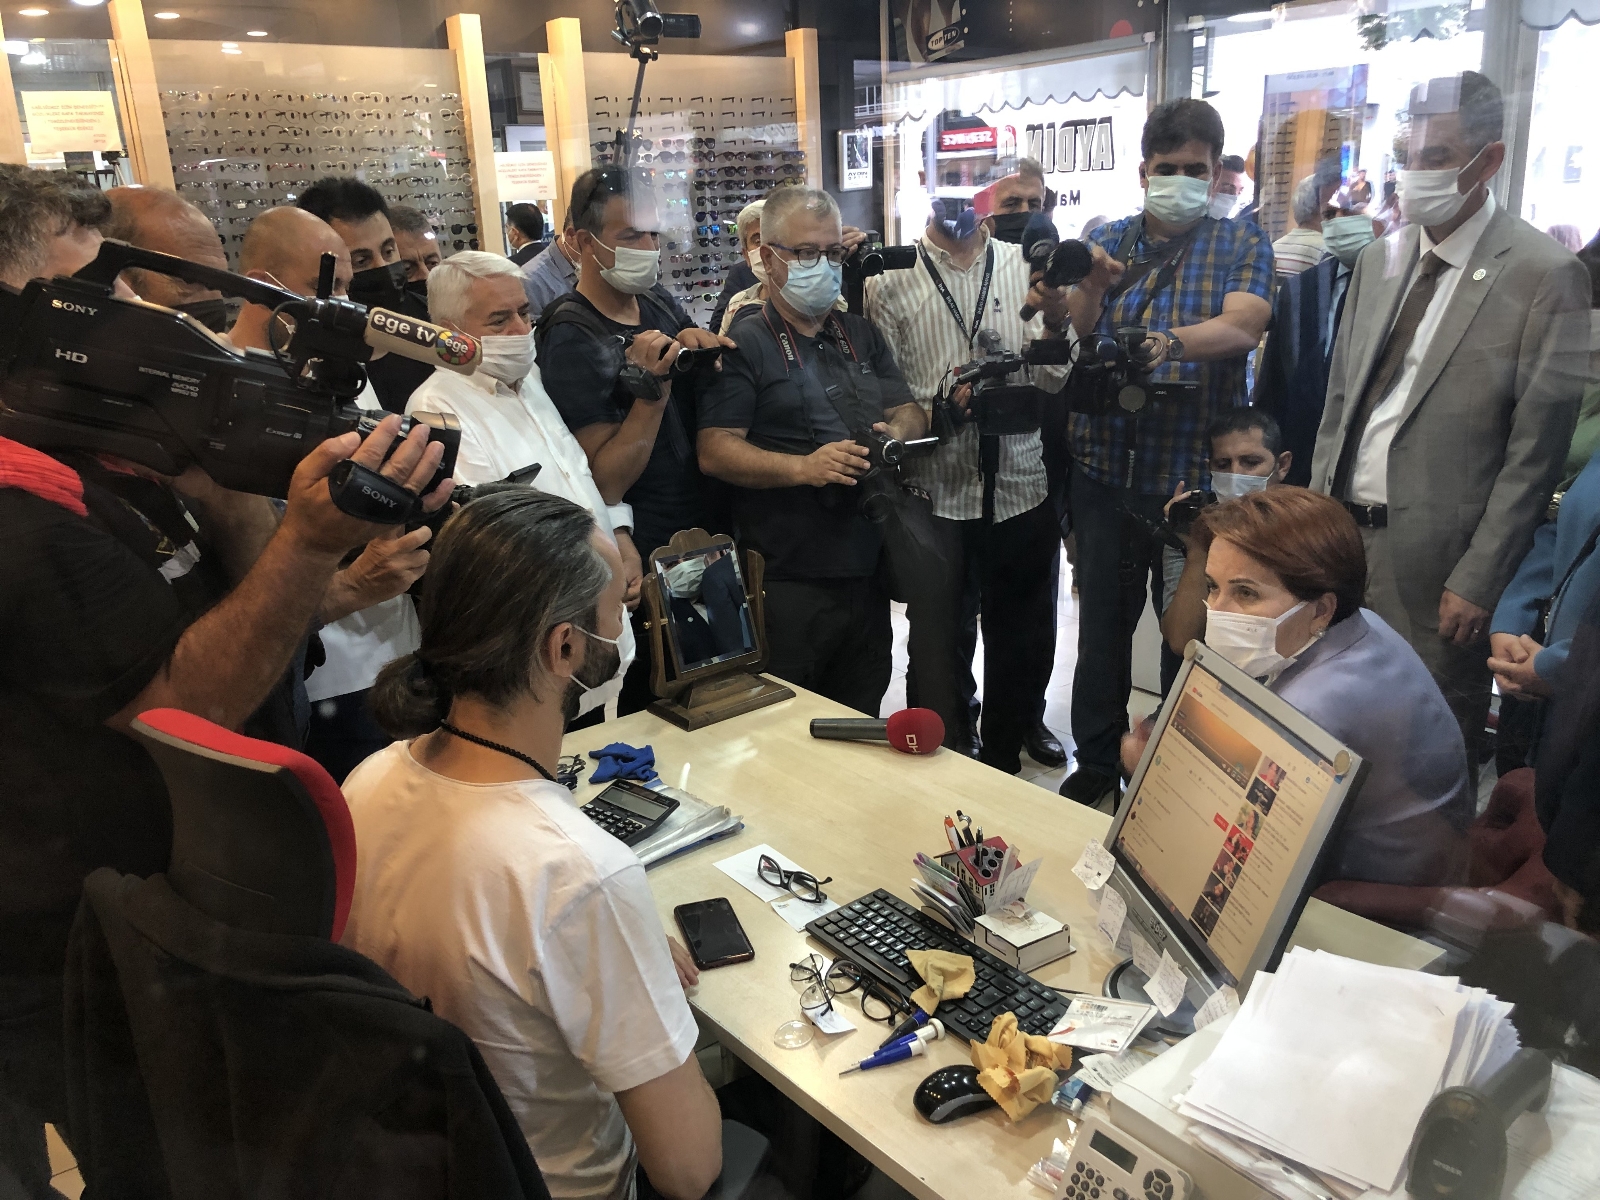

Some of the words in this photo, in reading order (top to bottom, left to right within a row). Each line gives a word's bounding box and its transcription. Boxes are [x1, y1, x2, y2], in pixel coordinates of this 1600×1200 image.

[931, 36, 943, 47] TOP
[943, 30, 957, 41] TEN
[52, 299, 98, 316] SONY
[373, 314, 411, 334] ege
[416, 326, 436, 343] tv
[445, 338, 469, 353] ege
[780, 332, 795, 361] Canon
[55, 348, 89, 364] HD
[138, 366, 171, 379] INTERNAL
[172, 373, 201, 385] MEMORY
[361, 485, 398, 508] SONY
